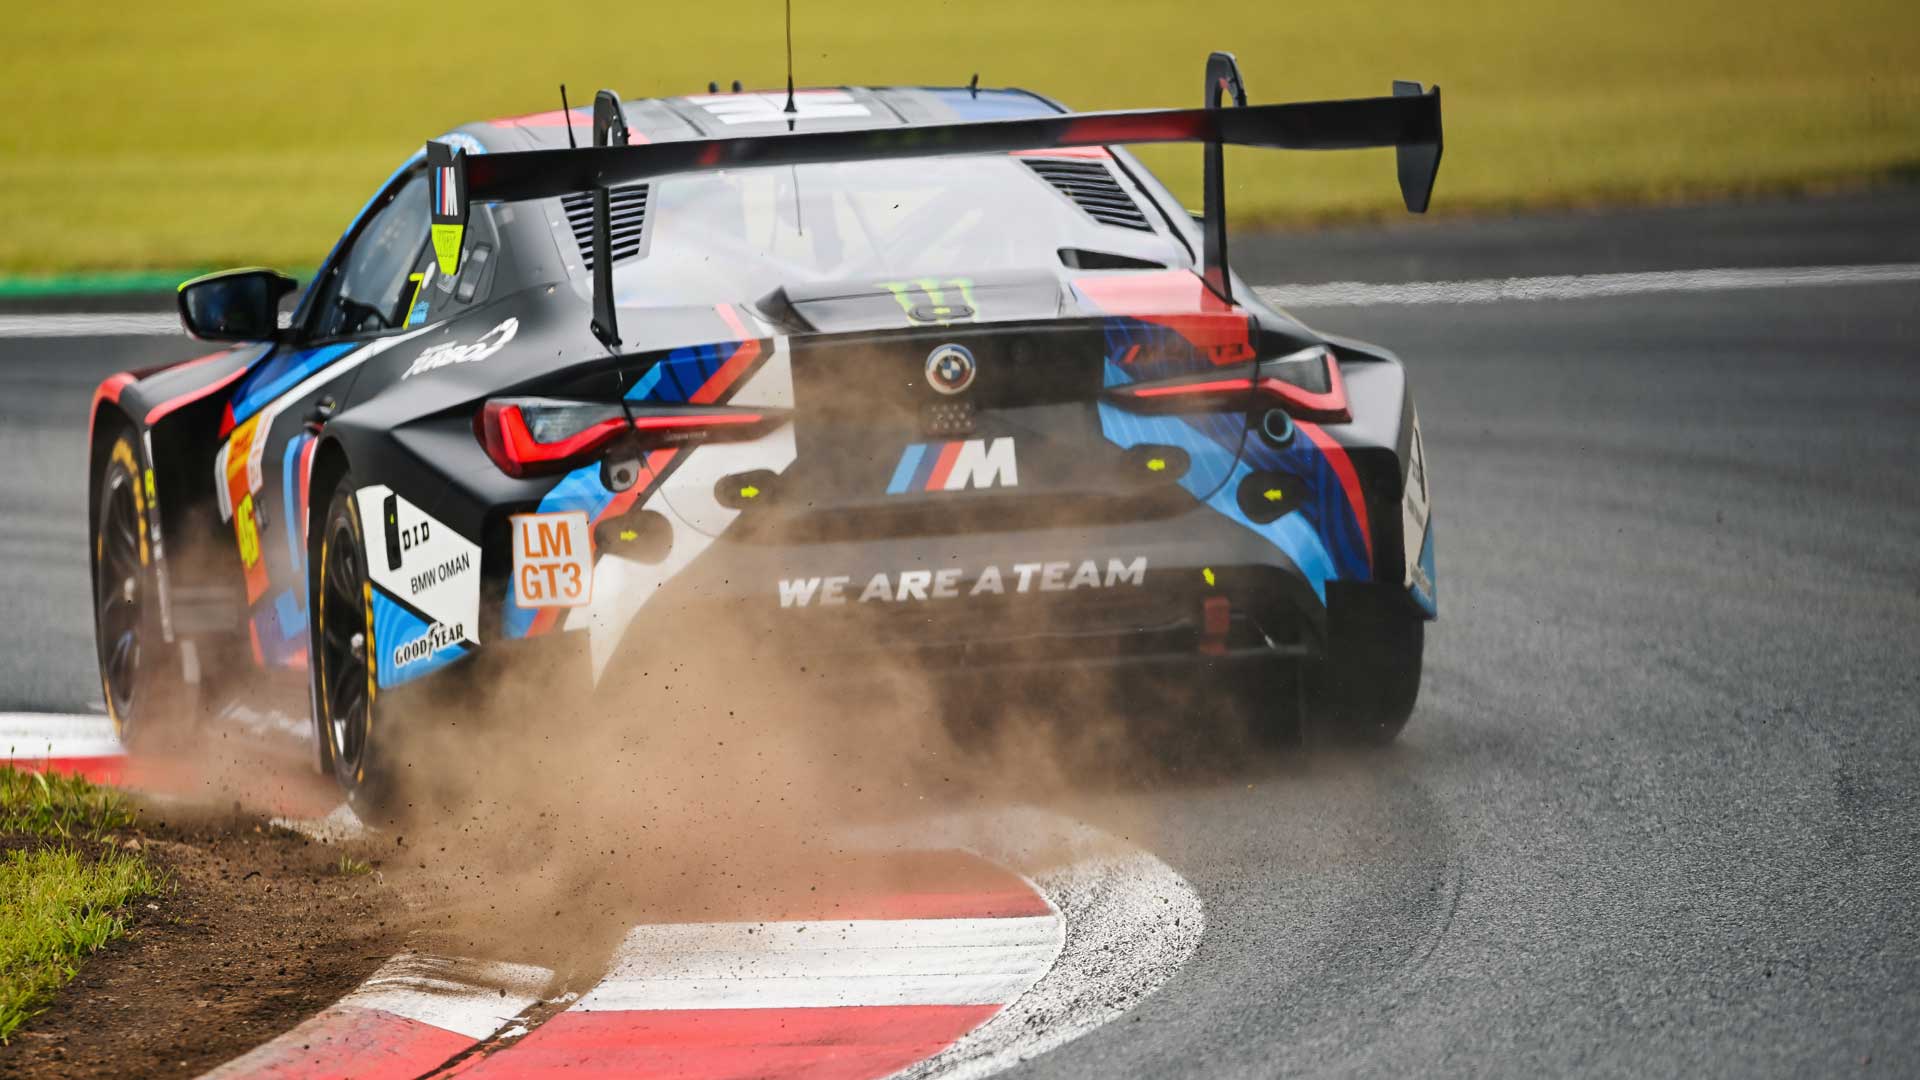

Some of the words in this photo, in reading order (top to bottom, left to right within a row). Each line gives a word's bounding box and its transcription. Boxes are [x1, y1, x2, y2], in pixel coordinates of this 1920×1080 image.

[944, 436, 1019, 491] M
[402, 521, 430, 551] DID
[522, 521, 572, 557] LM
[410, 567, 436, 595] BMW
[438, 552, 470, 582] OMAN
[521, 562, 582, 600] GT3
[778, 576, 850, 608] WE
[857, 568, 963, 603] ARE
[969, 565, 1004, 596] A
[1013, 557, 1148, 592] TEAM
[394, 622, 465, 668] GOODYEAR
